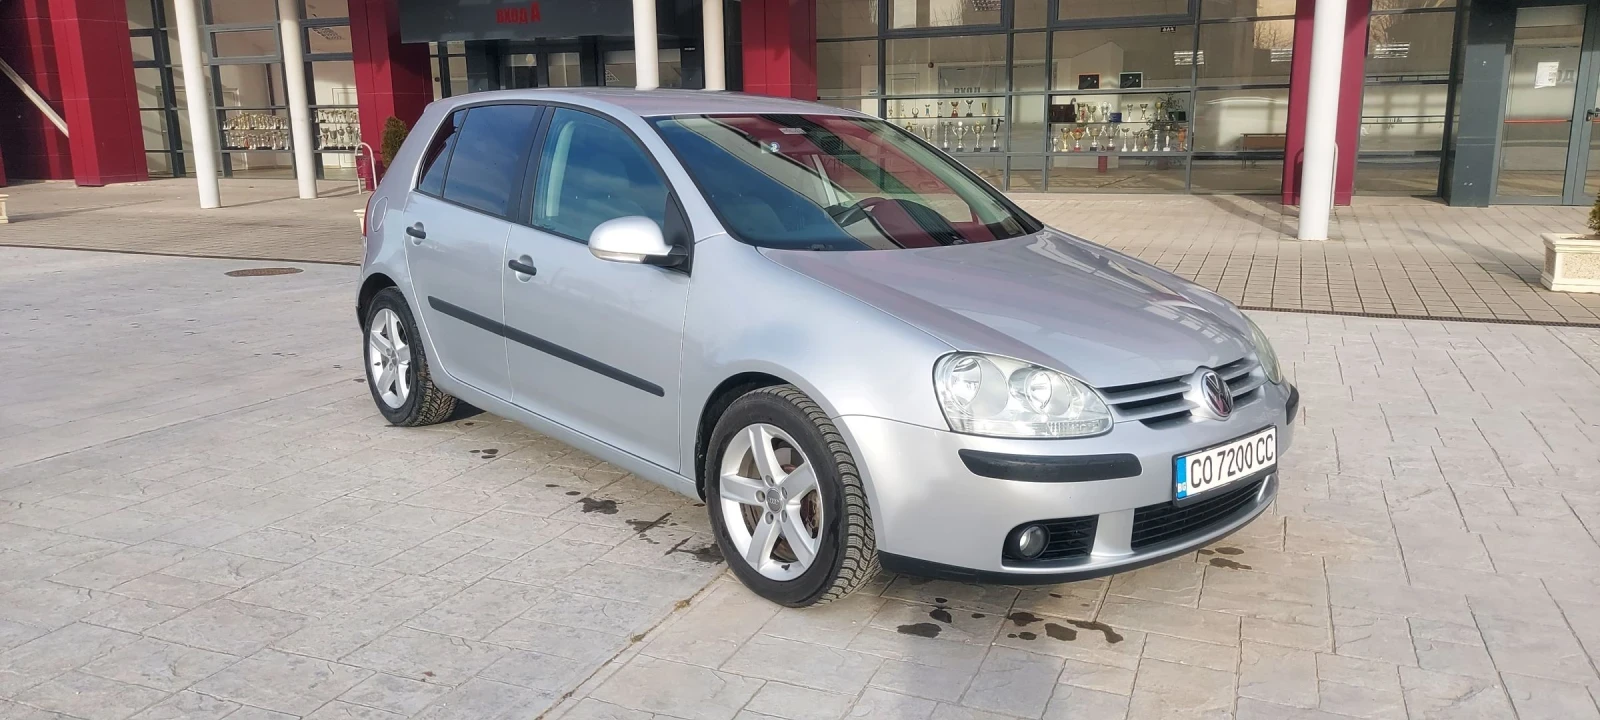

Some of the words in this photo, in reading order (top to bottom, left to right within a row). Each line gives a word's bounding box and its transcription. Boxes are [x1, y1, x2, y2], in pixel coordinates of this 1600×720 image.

[496, 8, 528, 24] ВХОД
[1190, 455, 1213, 489] CO
[1217, 441, 1253, 481] 7200
[1256, 433, 1274, 465] CC
